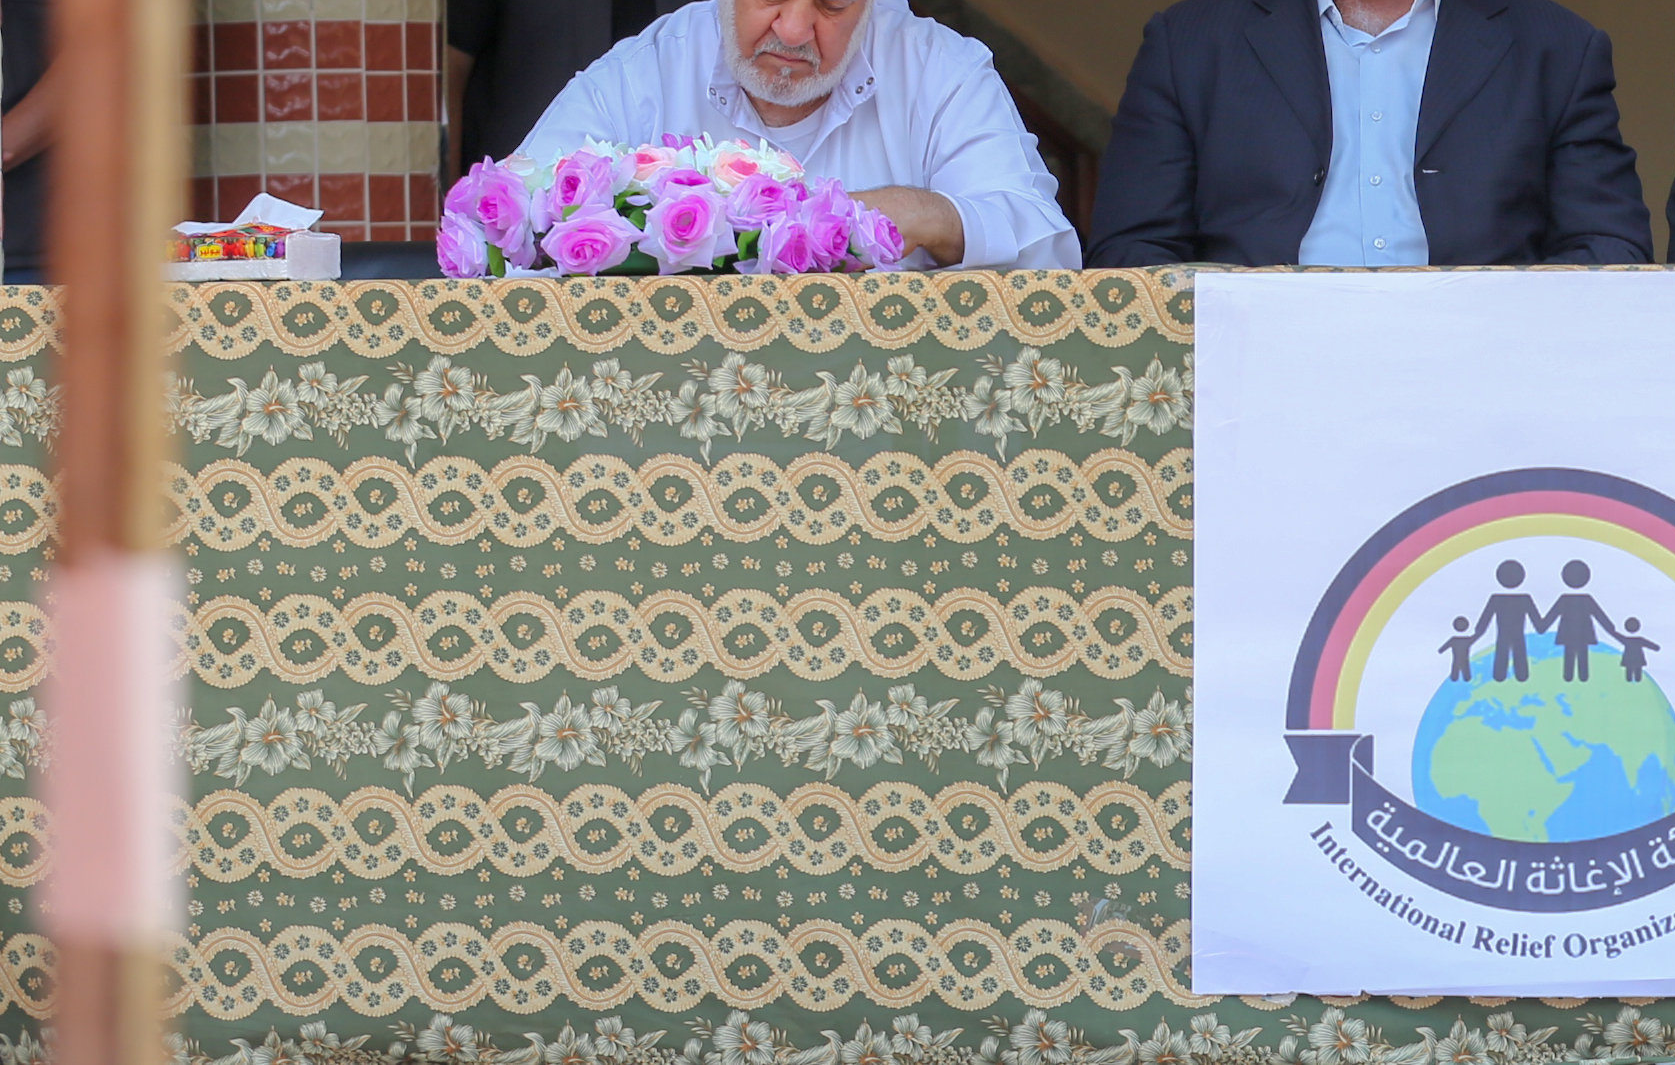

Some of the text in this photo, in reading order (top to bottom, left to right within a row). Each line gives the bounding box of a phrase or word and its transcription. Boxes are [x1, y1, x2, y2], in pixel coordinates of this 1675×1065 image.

[1309, 821, 1467, 945] International
[1472, 925, 1556, 959] Relief
[1366, 801, 1517, 892] العالمية
[1525, 848, 1645, 895] الإغاثة
